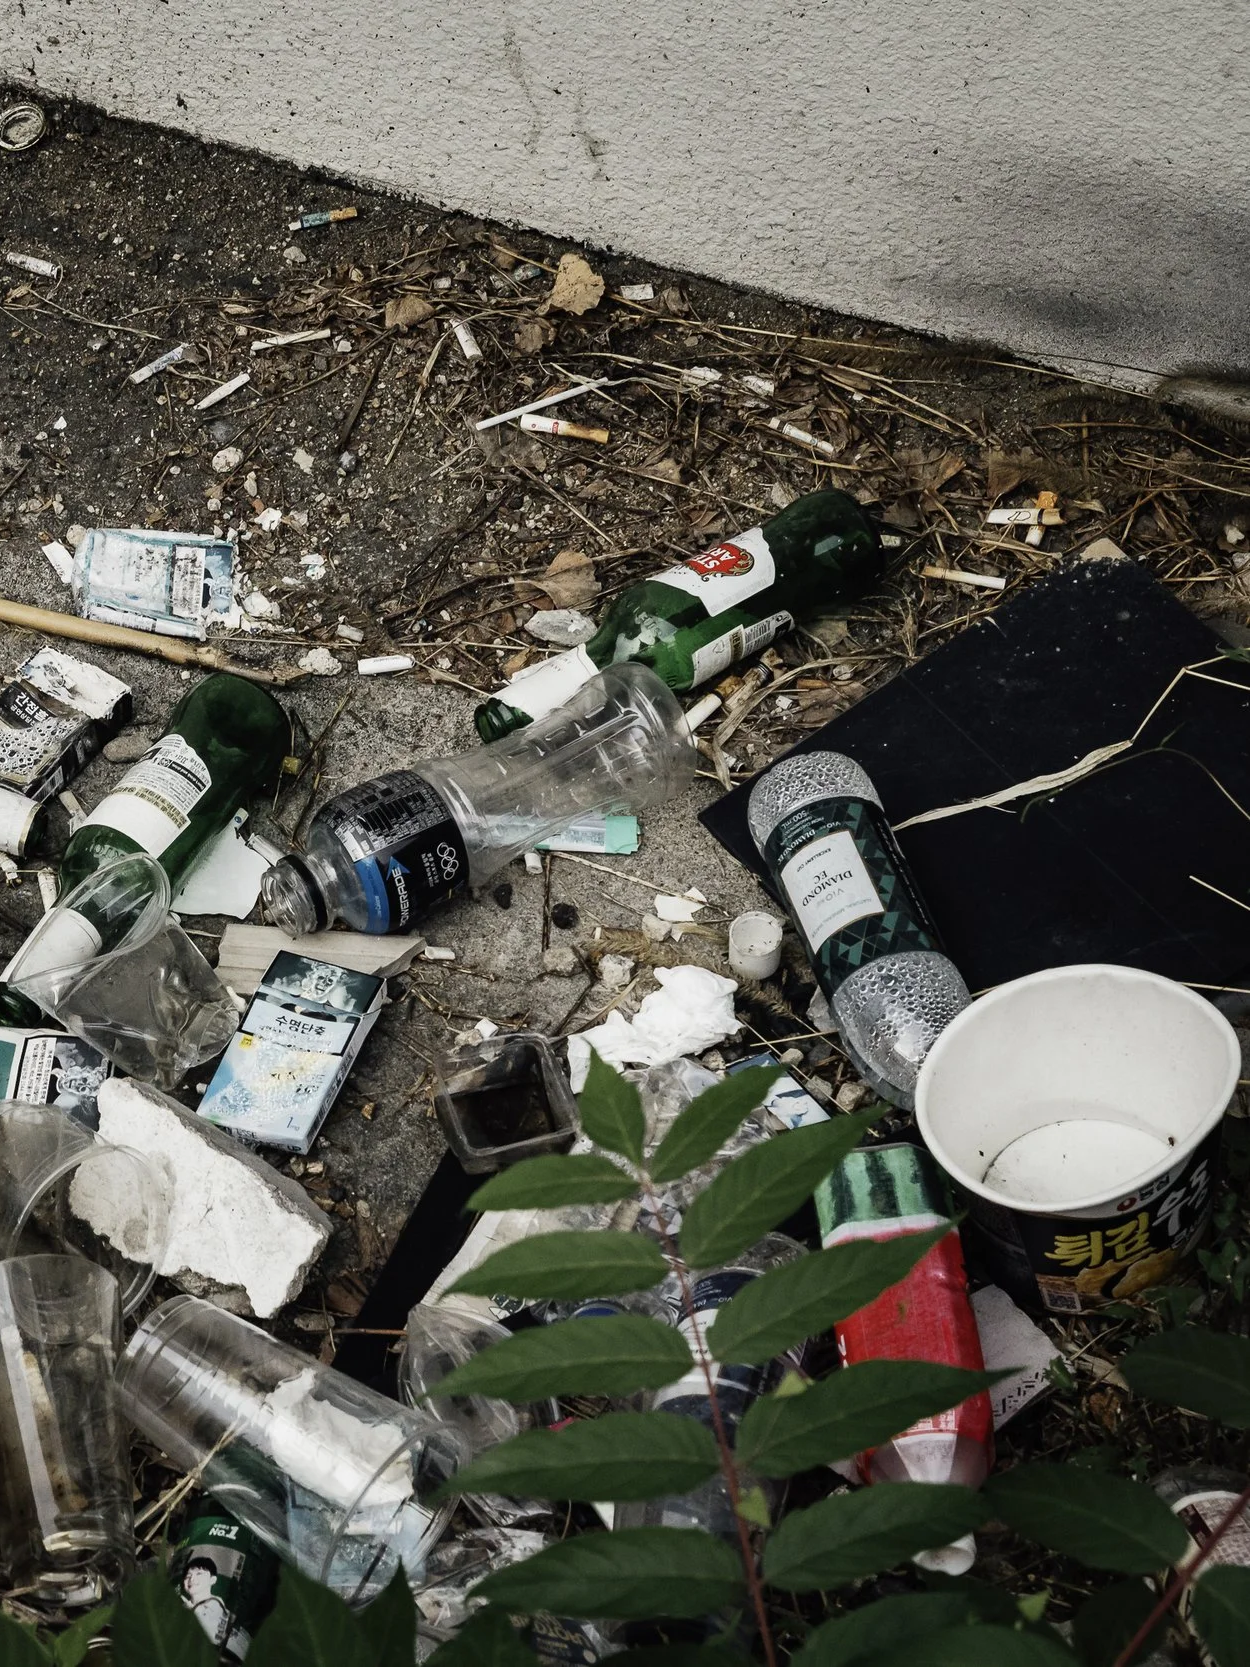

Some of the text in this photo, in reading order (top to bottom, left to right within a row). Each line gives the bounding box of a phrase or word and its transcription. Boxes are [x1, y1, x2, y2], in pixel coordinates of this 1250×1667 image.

[14, 691, 49, 722] 간접흡
[186, 773, 198, 783] drink
[793, 810, 808, 822] 500
[782, 828, 817, 857] DIAMOND
[805, 847, 832, 866] EXCELLENT
[802, 870, 853, 907] DIAMOND
[813, 870, 828, 884] EC
[274, 1014, 327, 1039] 수명단축
[1044, 1211, 1157, 1268] 튀김
[1152, 1159, 1212, 1237] 우동
